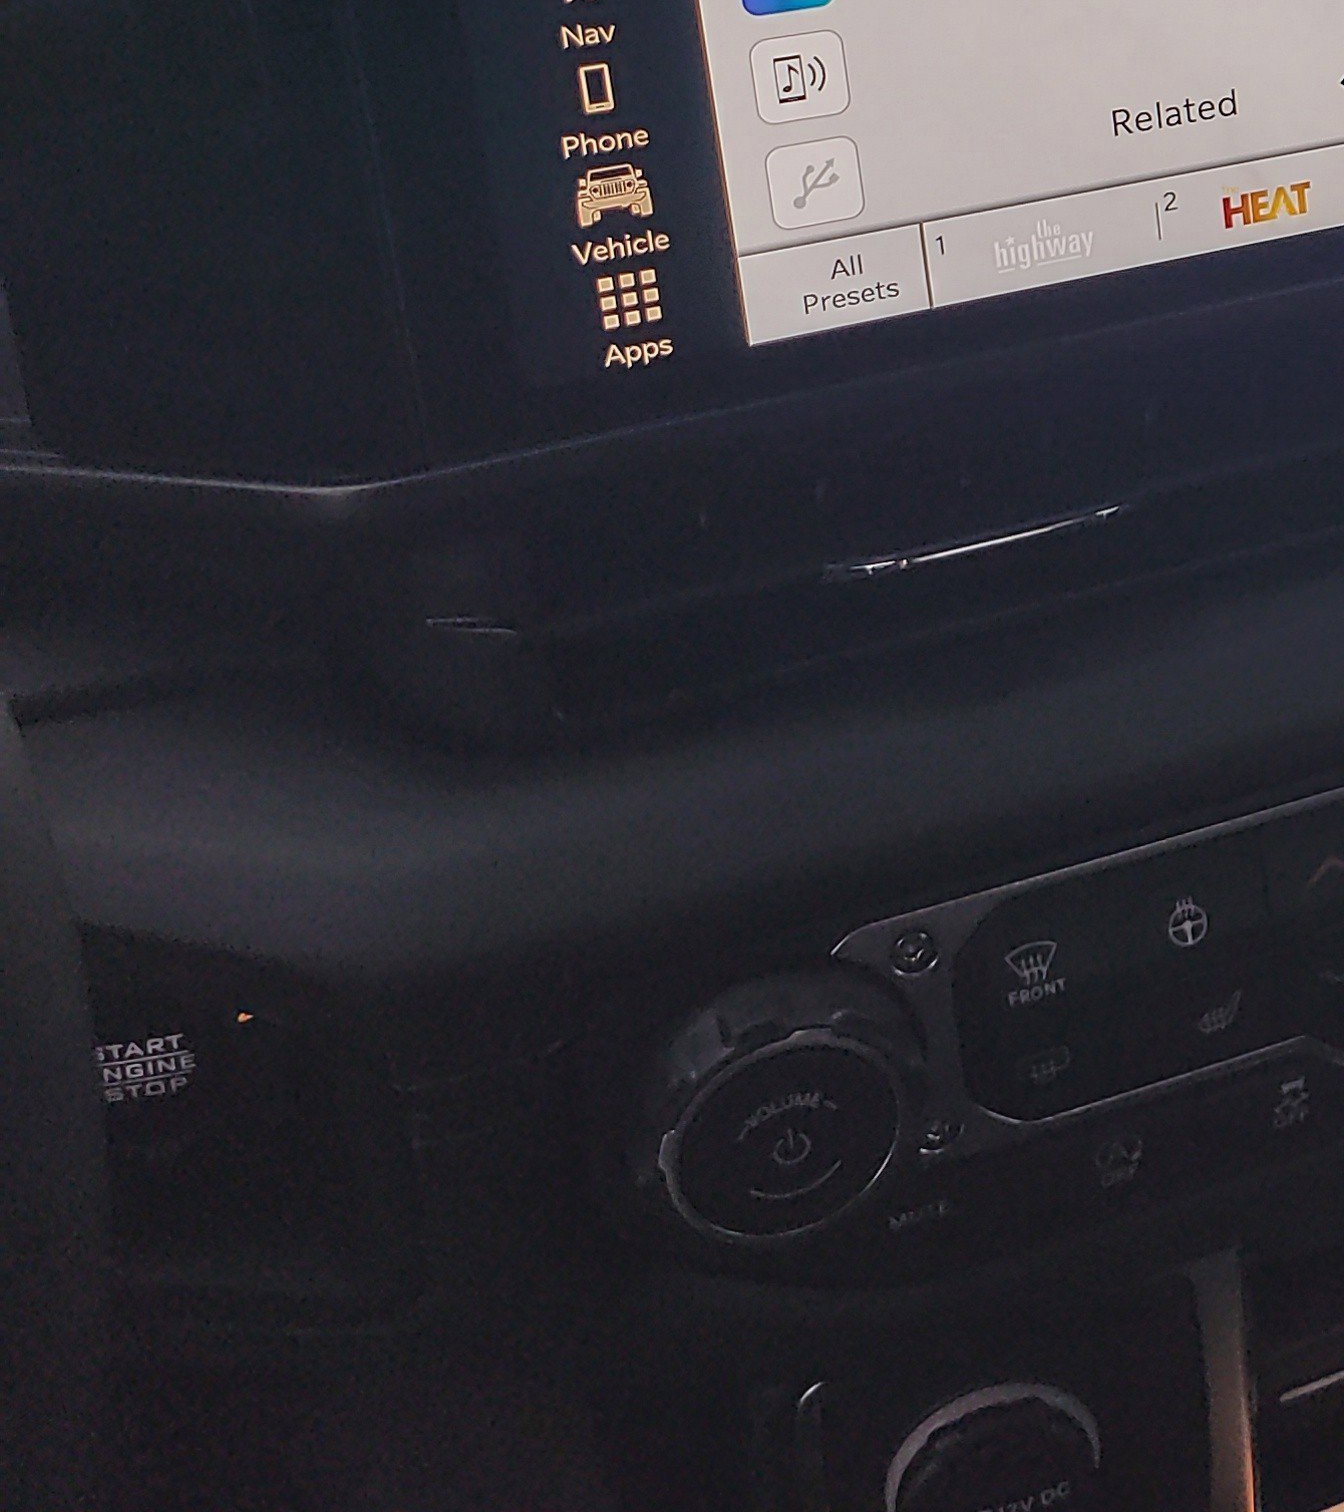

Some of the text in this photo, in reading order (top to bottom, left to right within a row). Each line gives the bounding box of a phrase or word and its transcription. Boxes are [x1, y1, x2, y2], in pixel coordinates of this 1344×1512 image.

[560, 21, 616, 50] Nav
[1111, 89, 1239, 137] Related
[561, 125, 651, 160] Phone
[1163, 191, 1179, 212] 2
[1222, 181, 1311, 230] HEAT
[936, 234, 946, 256] 1
[1036, 219, 1062, 239] the
[571, 227, 671, 266] Vehicle
[993, 231, 1094, 272] highway
[830, 254, 865, 281] All
[802, 278, 901, 315] Presets
[603, 336, 674, 370] Apps
[1007, 976, 1068, 1007] FRONT
[103, 1076, 190, 1103] STOP
